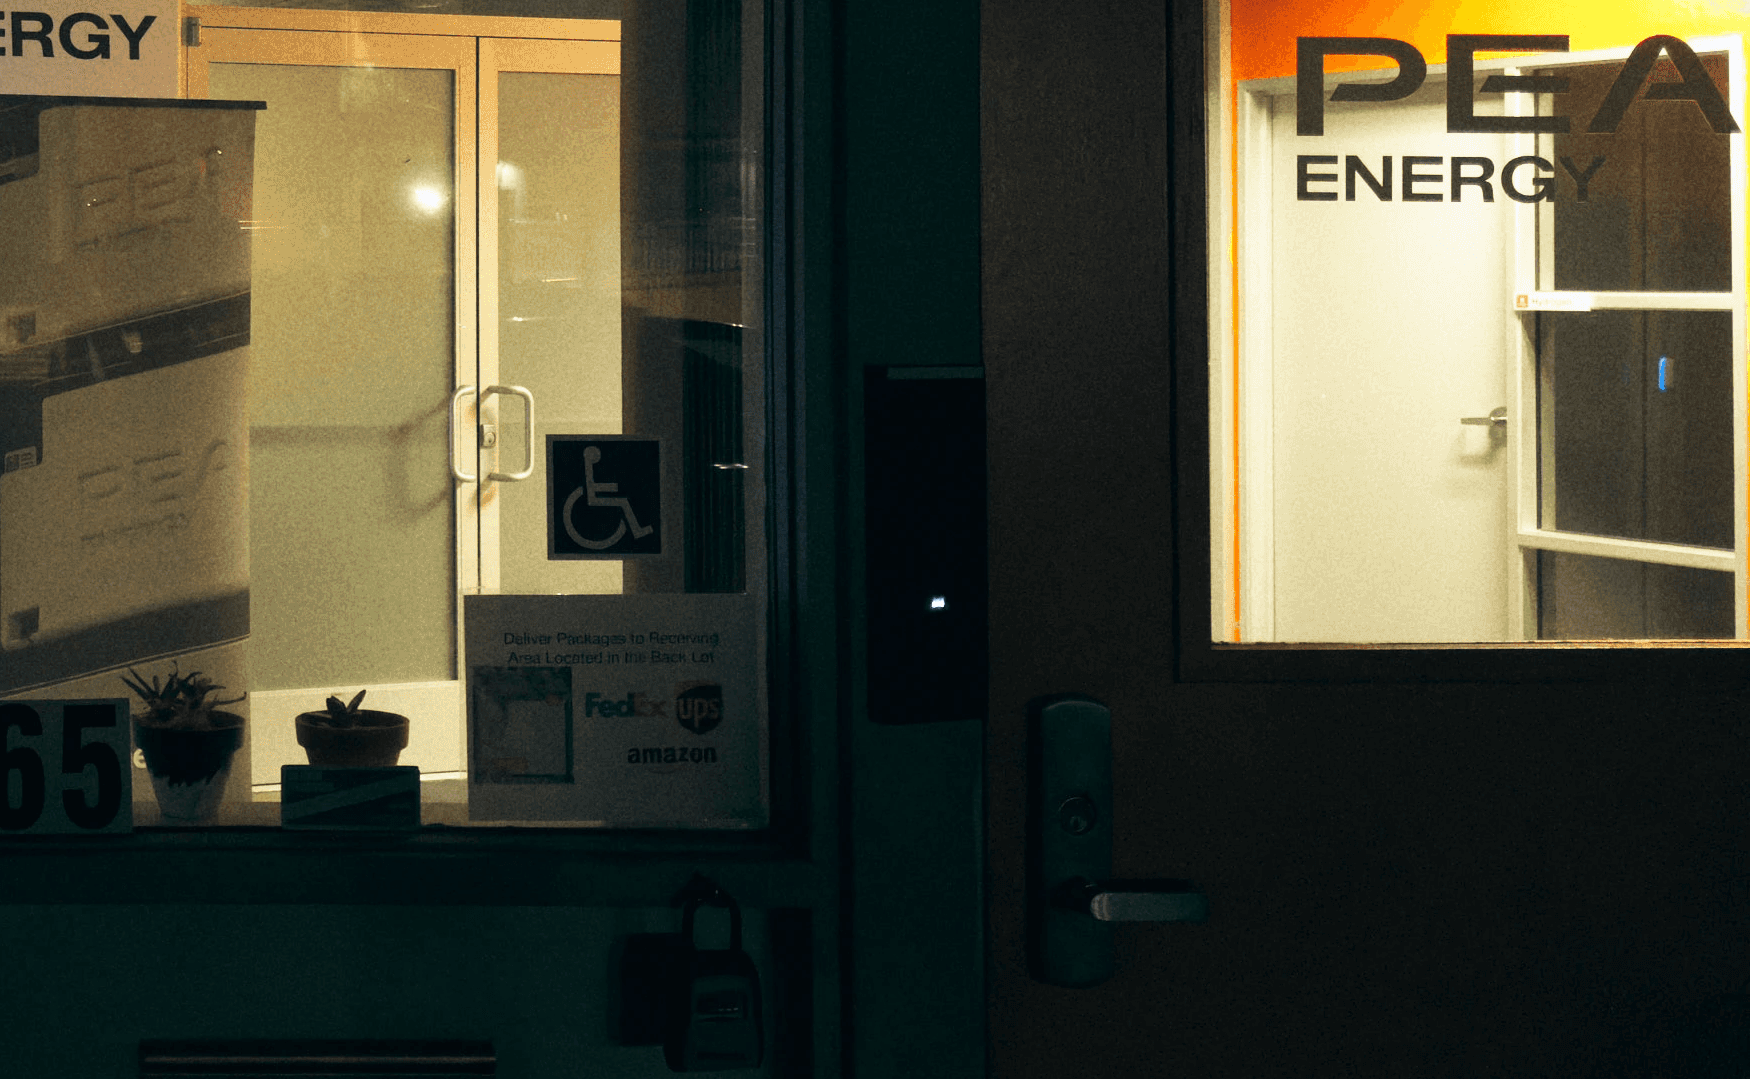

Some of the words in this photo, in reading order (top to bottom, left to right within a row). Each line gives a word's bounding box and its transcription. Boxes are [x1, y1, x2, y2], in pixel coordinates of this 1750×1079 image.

[1297, 34, 1742, 136] PEA
[1297, 154, 1606, 204] ENERGY
[504, 631, 552, 645] Deliver
[557, 631, 626, 647] Packages
[631, 632, 645, 645] to
[649, 631, 720, 648] Receiving
[507, 651, 541, 664] Area
[546, 651, 603, 664] Located
[607, 651, 620, 664] in
[624, 651, 647, 664] the
[651, 650, 686, 664] Back
[691, 651, 715, 664] Lot
[585, 691, 667, 718] FedEx
[677, 697, 721, 729] ups
[627, 746, 718, 764] amazon
